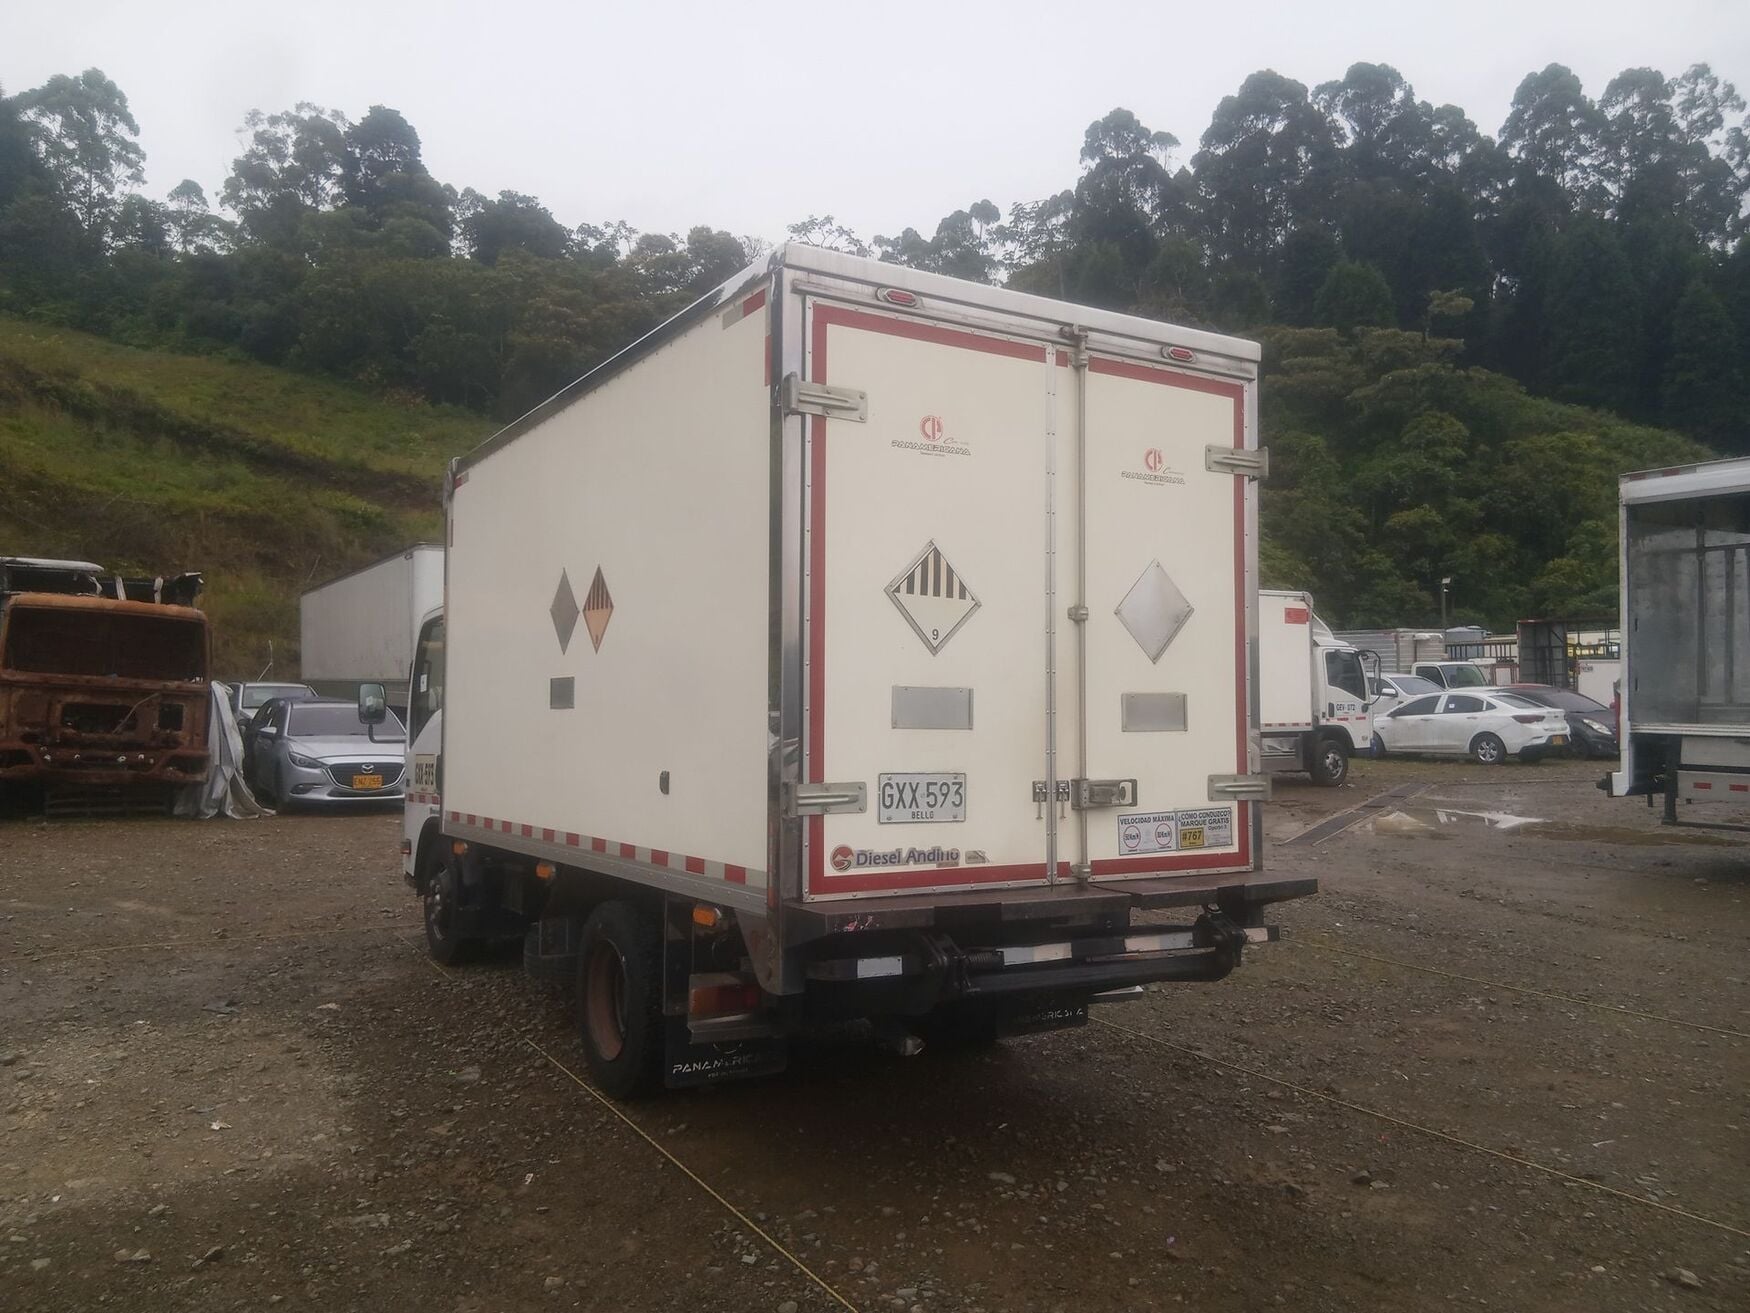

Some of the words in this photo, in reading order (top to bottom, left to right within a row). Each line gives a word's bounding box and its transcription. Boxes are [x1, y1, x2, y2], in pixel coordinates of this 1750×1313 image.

[932, 628, 944, 641] 9
[881, 782, 920, 810] GXX
[926, 781, 964, 808] 593
[911, 811, 935, 820] BELLO
[1119, 817, 1152, 825] VELOCIDAD
[1180, 819, 1207, 827] MARQUE
[1207, 817, 1230, 825] GRATIS
[1182, 830, 1202, 841] #767
[856, 849, 901, 866] Diesel
[906, 847, 961, 864] Andino
